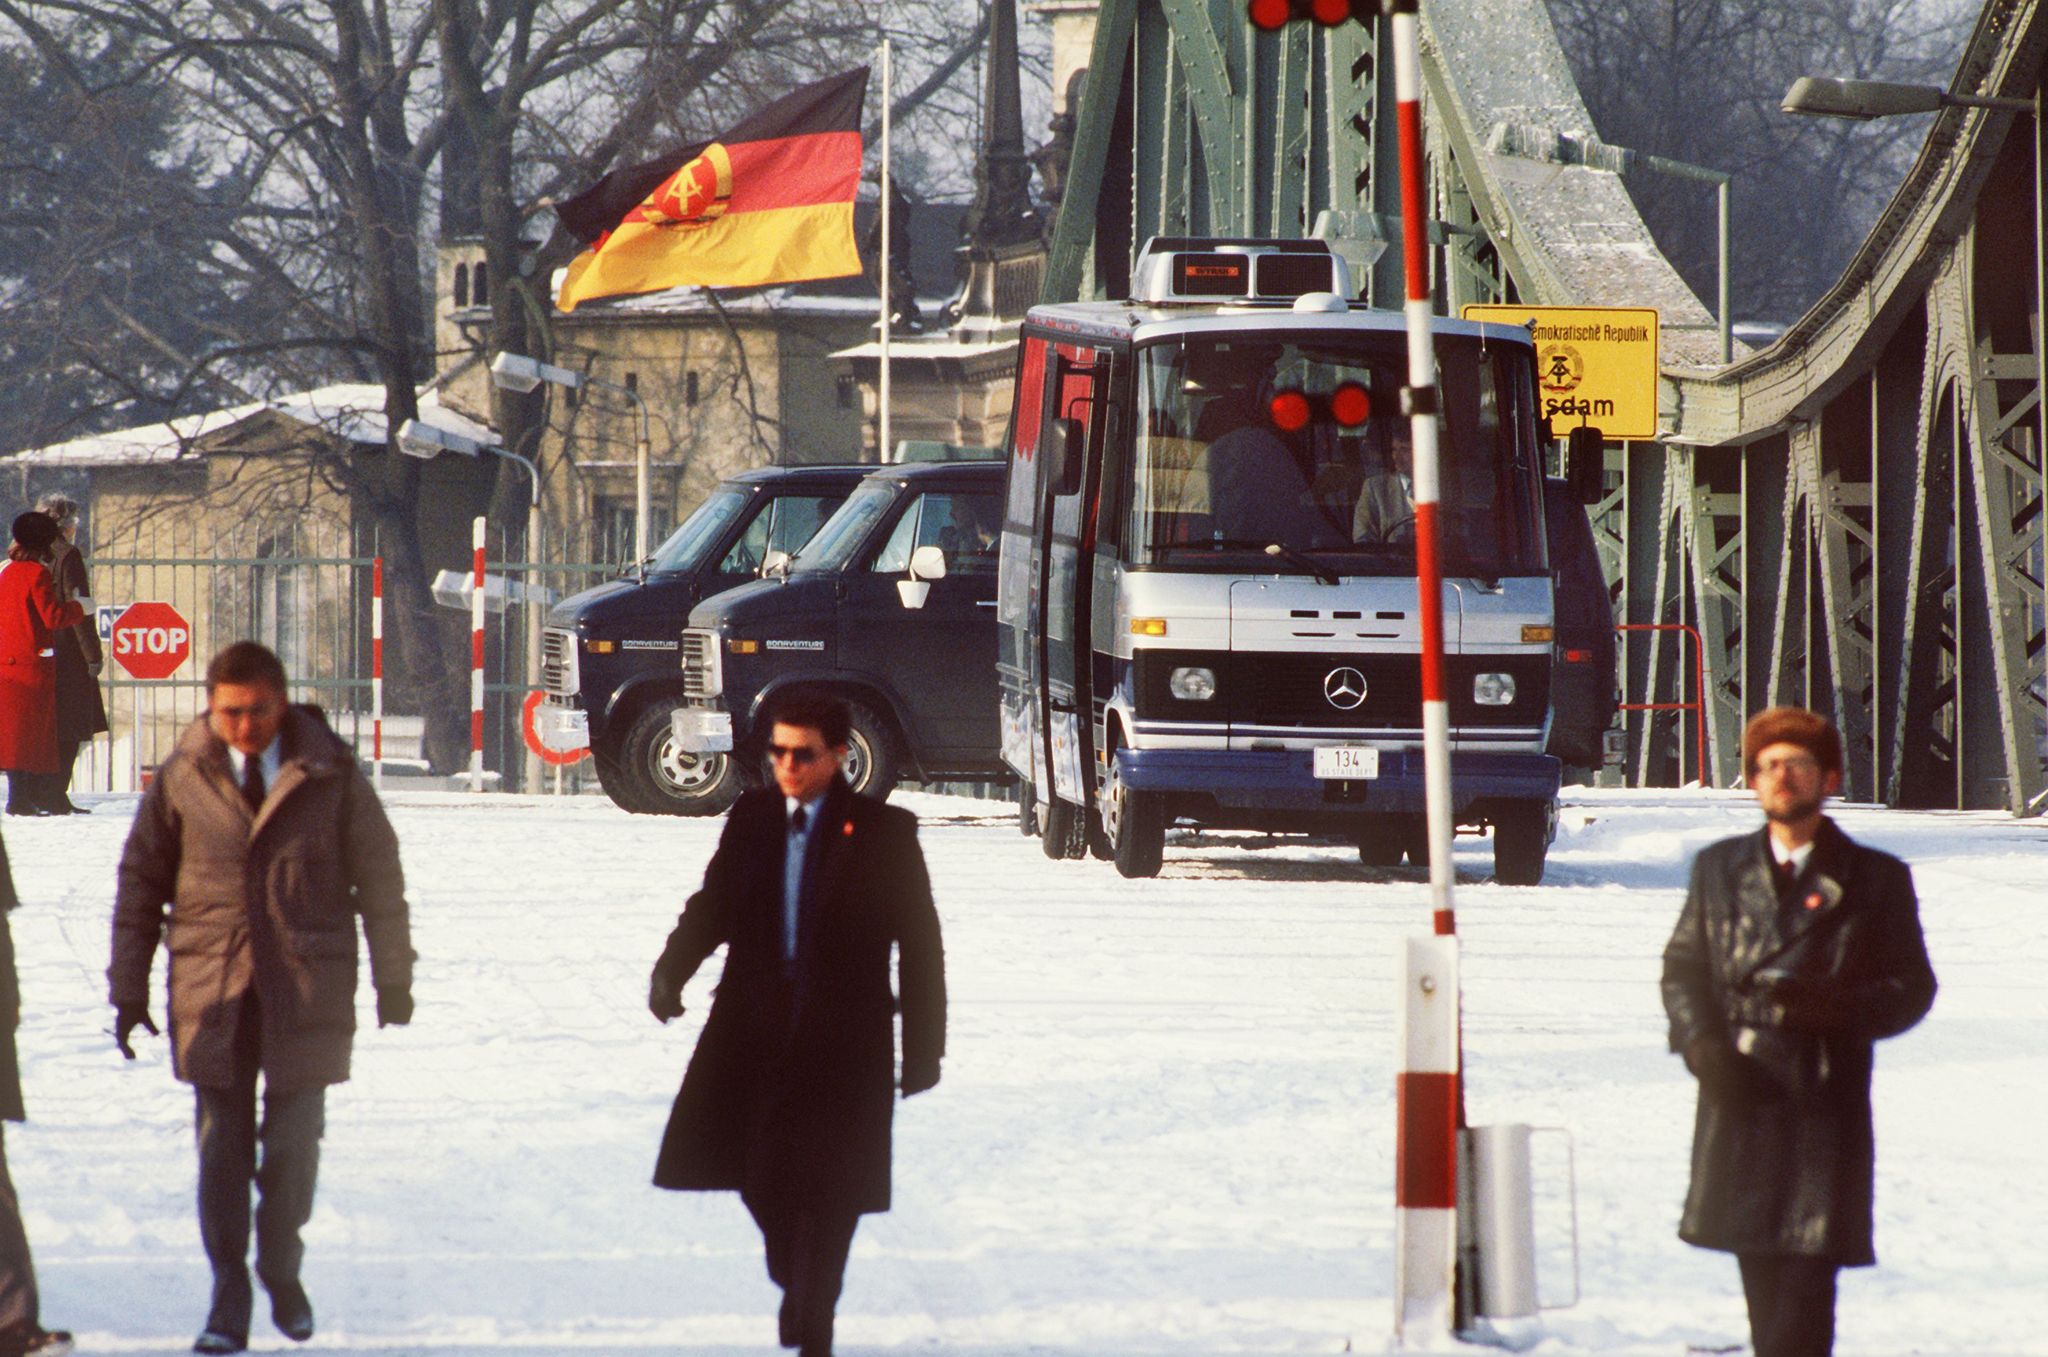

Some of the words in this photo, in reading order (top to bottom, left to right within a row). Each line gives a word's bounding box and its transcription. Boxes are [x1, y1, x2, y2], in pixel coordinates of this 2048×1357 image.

[1532, 325, 1600, 342] emokratische
[1604, 325, 1648, 343] Republik
[1541, 396, 1614, 416] sdam
[116, 627, 187, 655] STOP
[1335, 750, 1359, 768] 134
